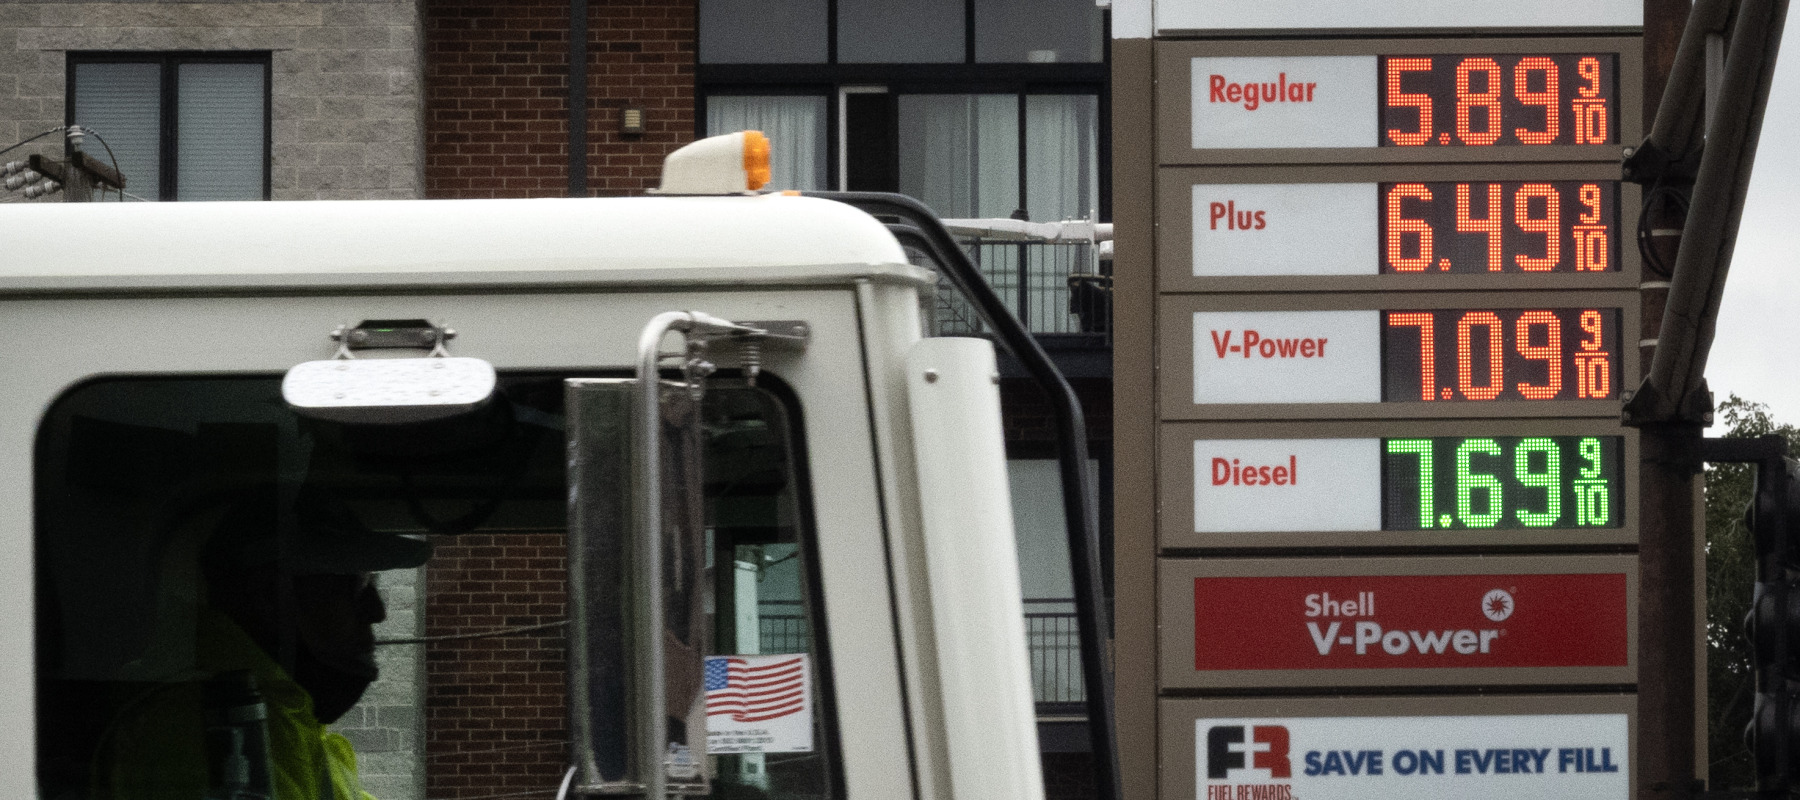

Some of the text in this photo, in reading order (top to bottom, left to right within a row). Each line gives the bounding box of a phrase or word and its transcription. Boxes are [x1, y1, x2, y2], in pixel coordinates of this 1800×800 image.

[1209, 73, 1317, 111] Regular
[1387, 57, 1560, 146] 5.89
[1209, 201, 1267, 231] Plus
[1387, 183, 1561, 272] 6.49
[1211, 330, 1328, 359] V-Power
[1388, 311, 1562, 400] 7.09
[1211, 455, 1297, 486] Diesel
[1388, 438, 1562, 528] 7.69
[1304, 591, 1374, 617] Shell
[1306, 621, 1499, 656] V-Power
[1304, 747, 1619, 776] SAVE ON EVERY FILL
[1208, 784, 1292, 800] FUEL REWARDS
